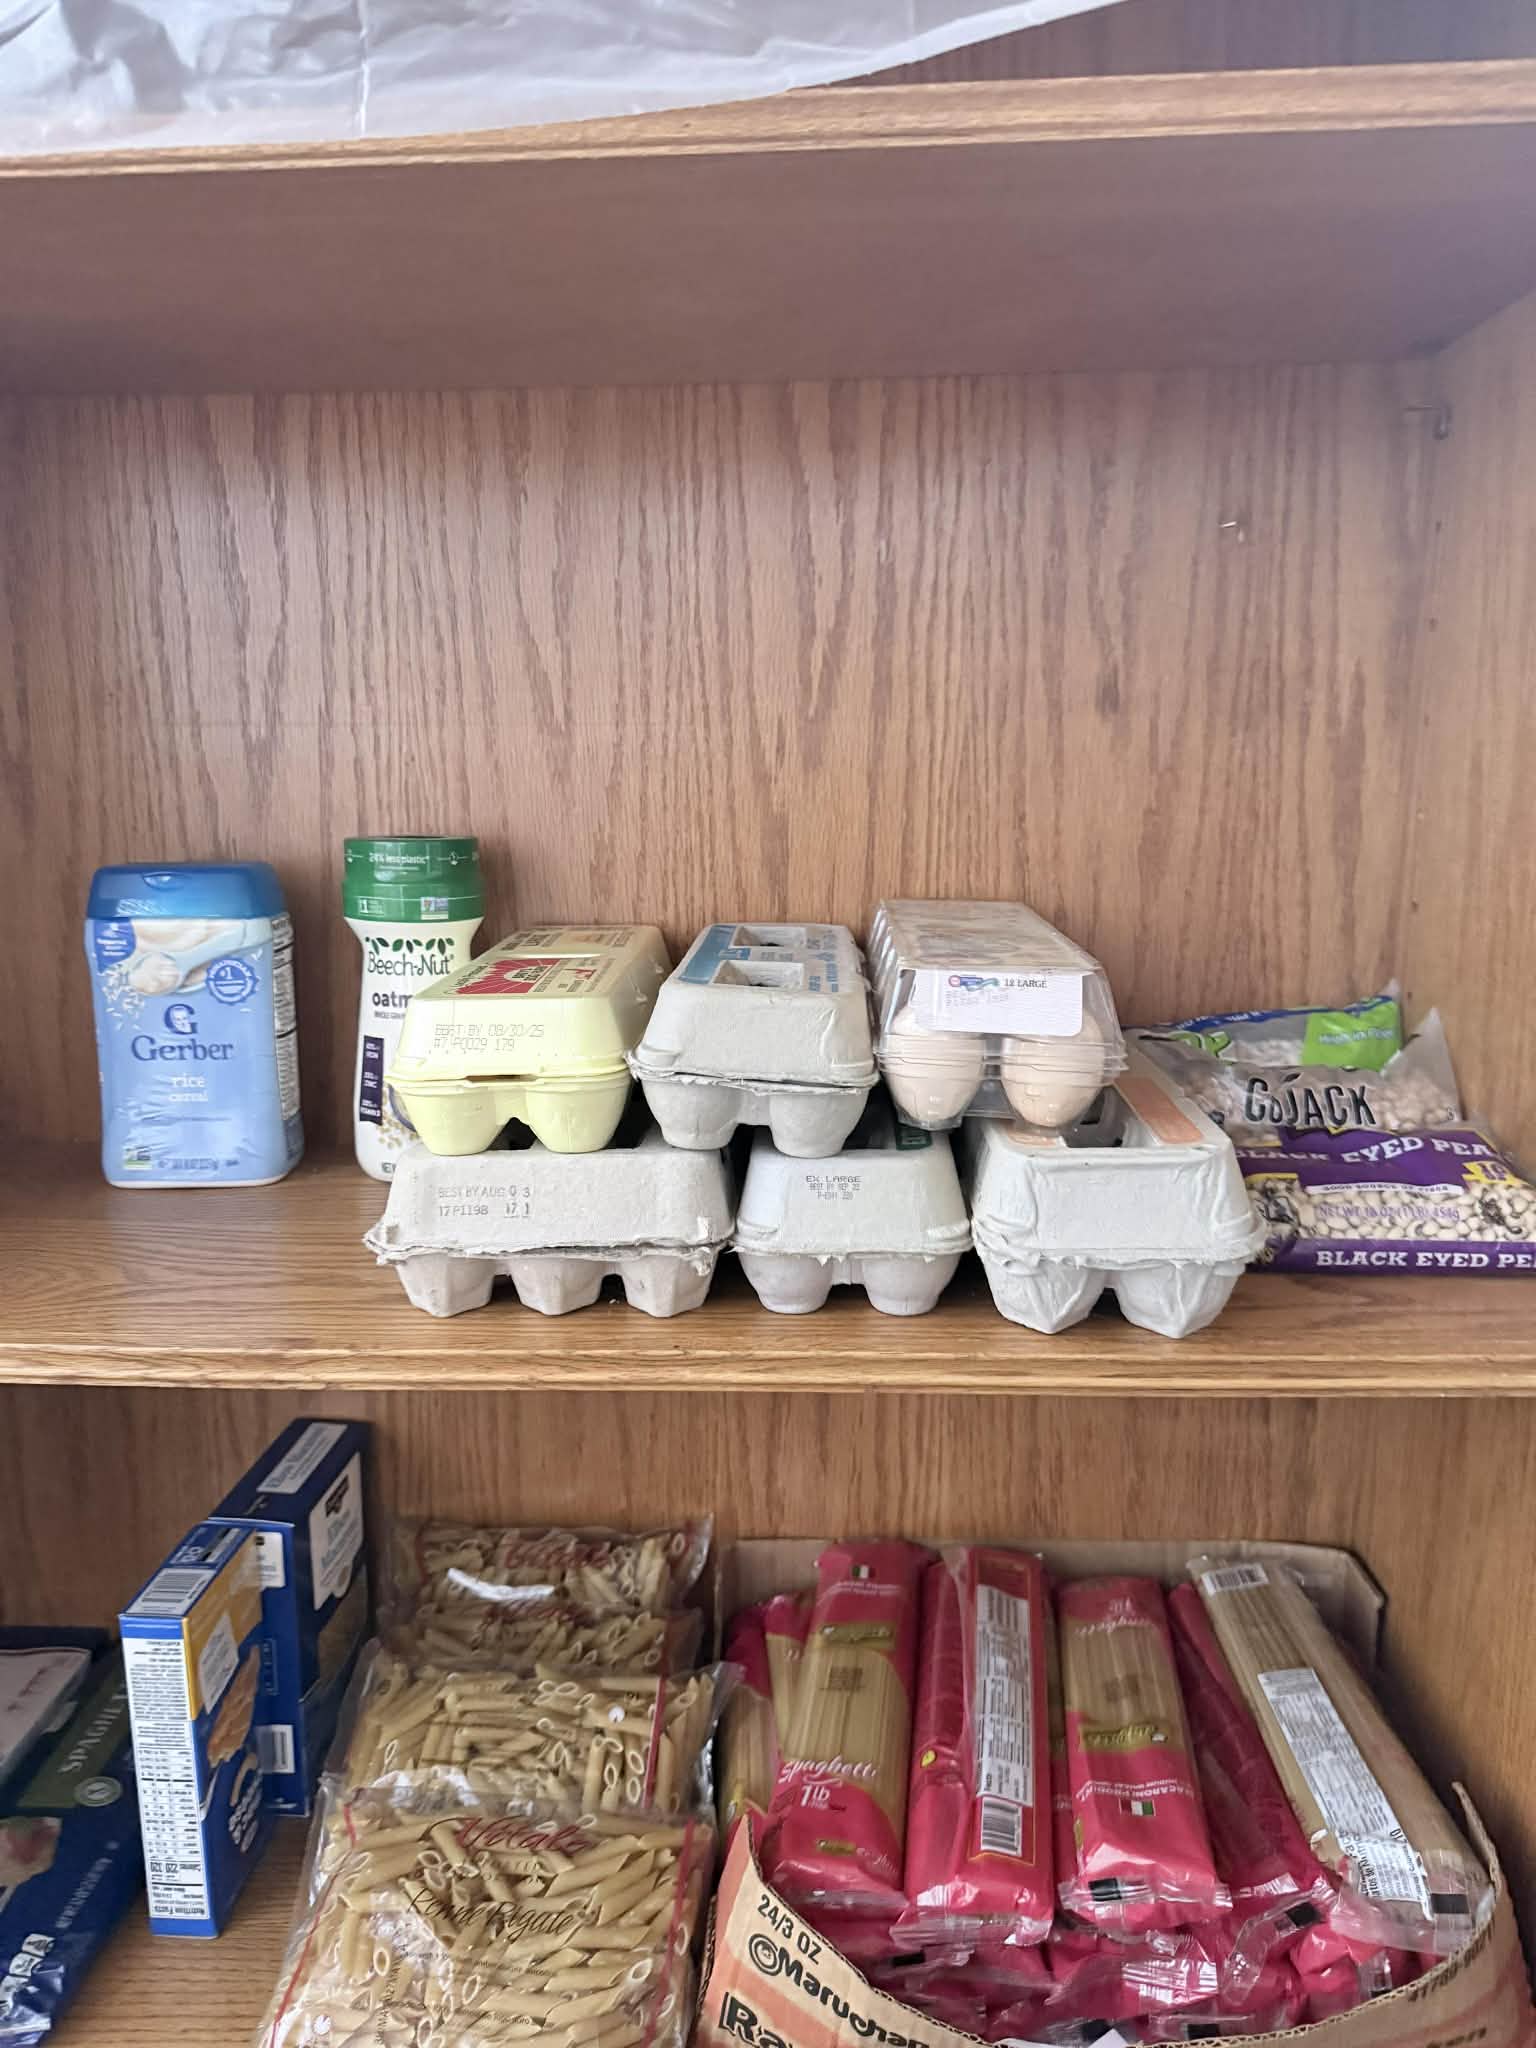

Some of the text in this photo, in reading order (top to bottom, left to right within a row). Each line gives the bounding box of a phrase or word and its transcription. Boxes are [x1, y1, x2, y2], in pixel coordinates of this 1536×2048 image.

[367, 950, 451, 976] Beech-Nut
[1017, 980, 1048, 989] LARGE
[131, 1034, 234, 1062] Gerber
[173, 1072, 206, 1088] rice
[1341, 1137, 1424, 1164] EYED
[805, 1175, 862, 1183] EX LARGE
[1316, 1249, 1536, 1271] BLACK EYED PE
[778, 1754, 878, 1785] spaghetti
[485, 1900, 576, 1945] Rigate
[757, 1894, 823, 1966] 24/3 OZ
[777, 1946, 931, 2048] Maruchan
